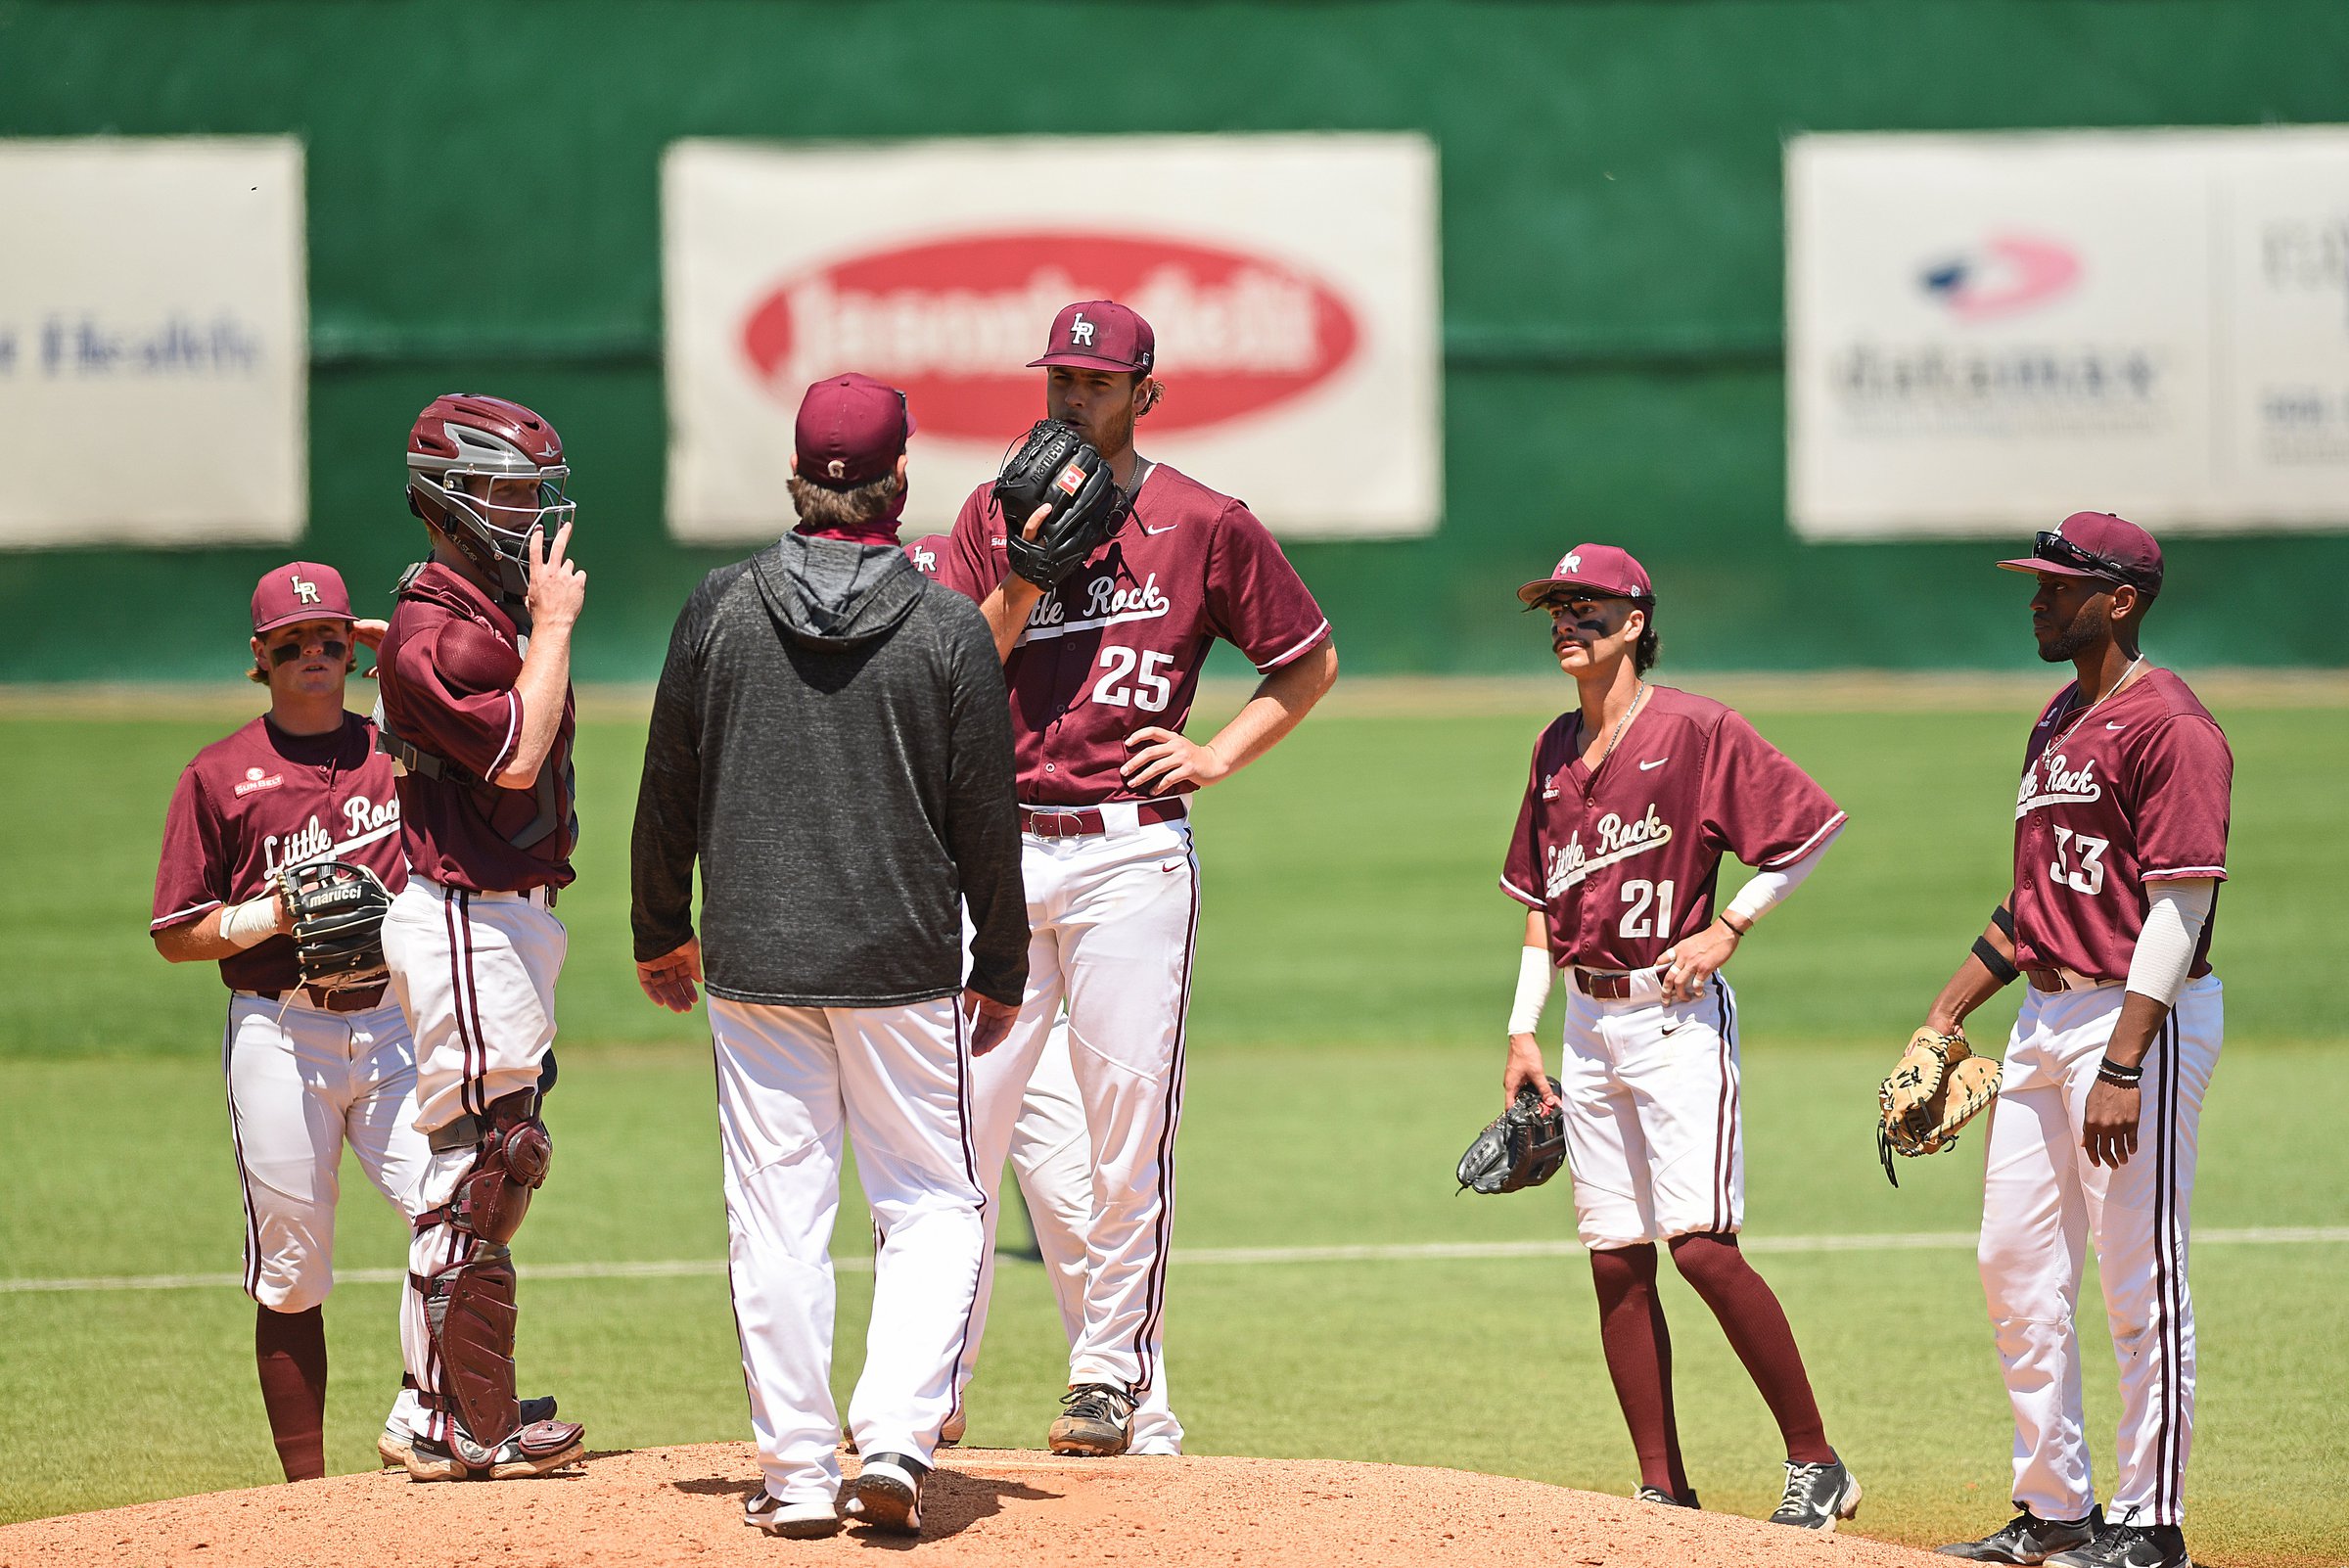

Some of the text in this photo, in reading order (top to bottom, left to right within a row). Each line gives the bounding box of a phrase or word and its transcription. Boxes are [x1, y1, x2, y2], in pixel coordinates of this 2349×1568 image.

[1070, 311, 1095, 347] LR
[912, 544, 937, 573] LR
[290, 575, 322, 604] LR
[1082, 572, 1163, 617] Rock
[1091, 645, 1174, 712] 25
[2045, 754, 2096, 794] Rock
[263, 814, 332, 880] Little
[1546, 803, 1662, 889] Little Rock
[309, 885, 362, 907] marucci
[1618, 879, 1676, 939] 21
